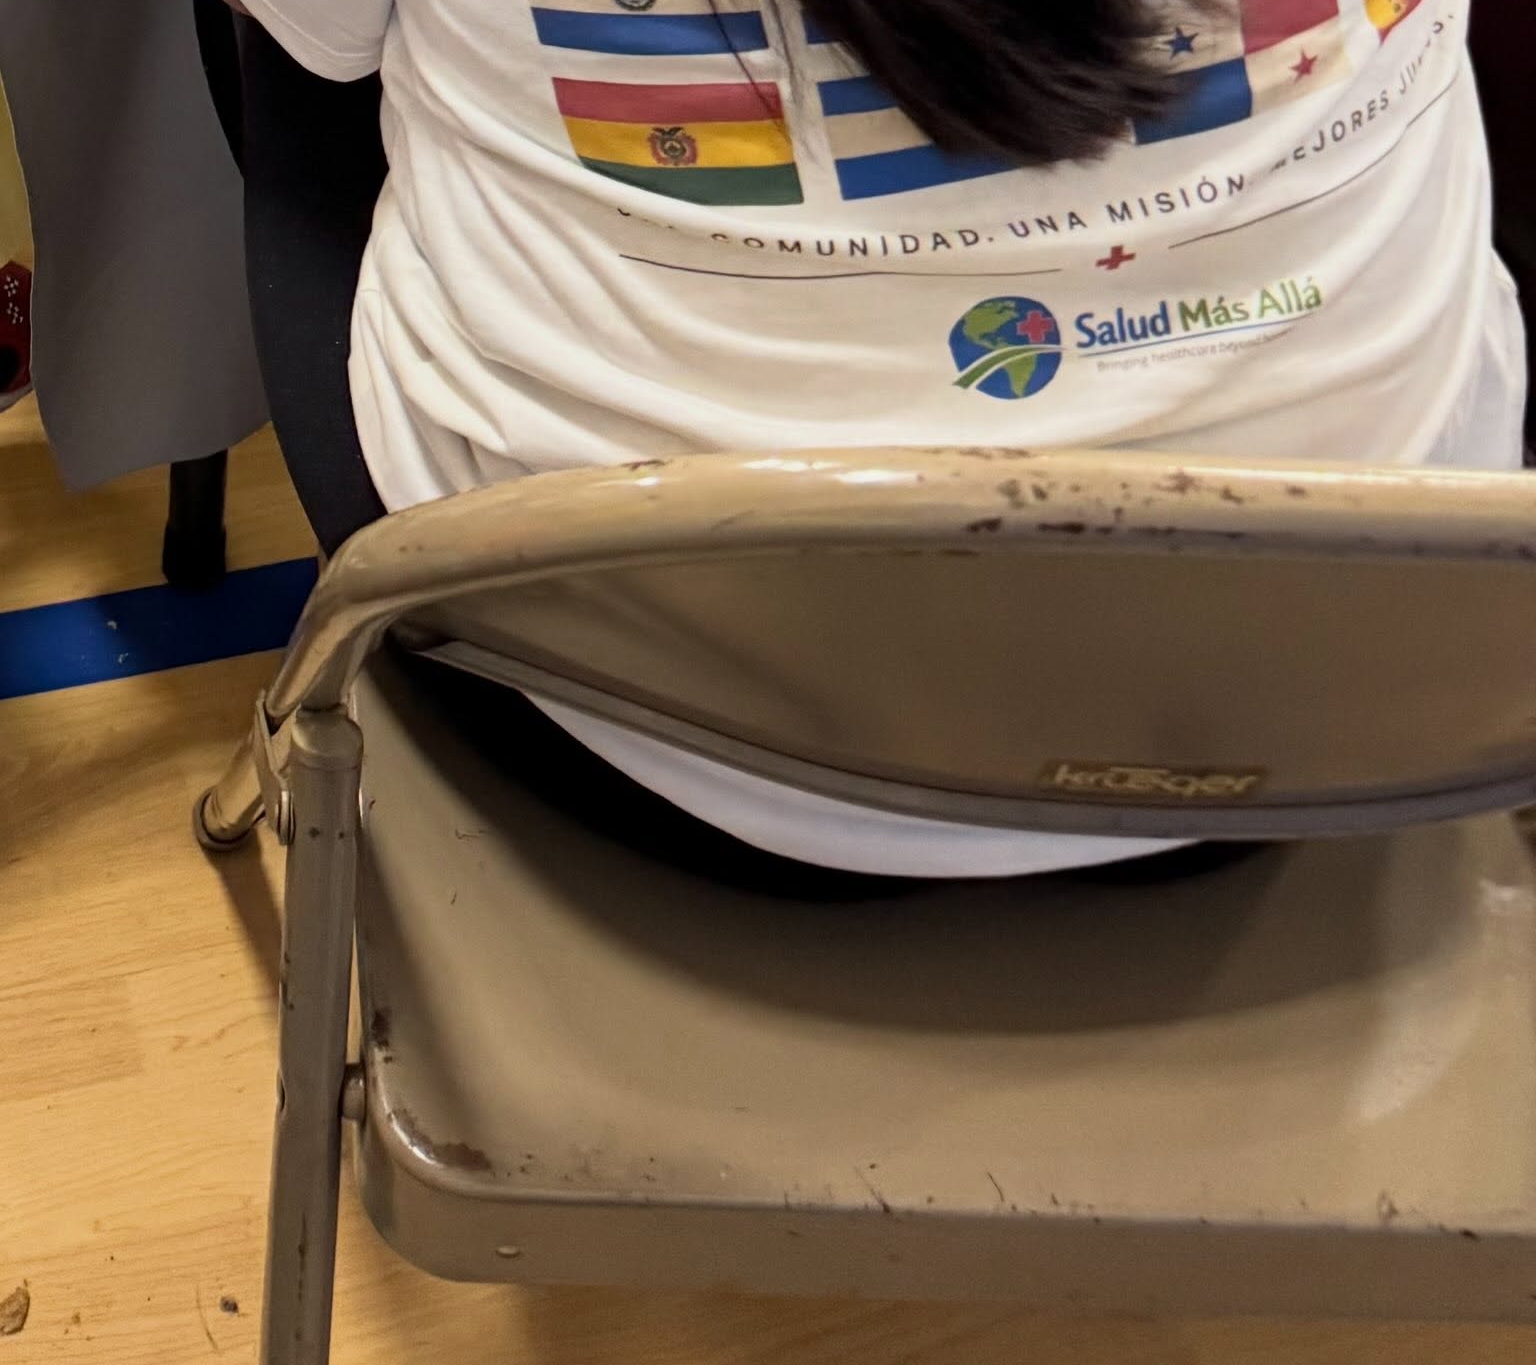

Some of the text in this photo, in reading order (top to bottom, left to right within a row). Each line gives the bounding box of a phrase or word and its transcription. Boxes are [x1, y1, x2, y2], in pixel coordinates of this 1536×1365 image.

[1008, 211, 1088, 239] UNA
[1105, 174, 1247, 223] MISIÓN
[1074, 276, 1323, 349] Salud Más Allá
